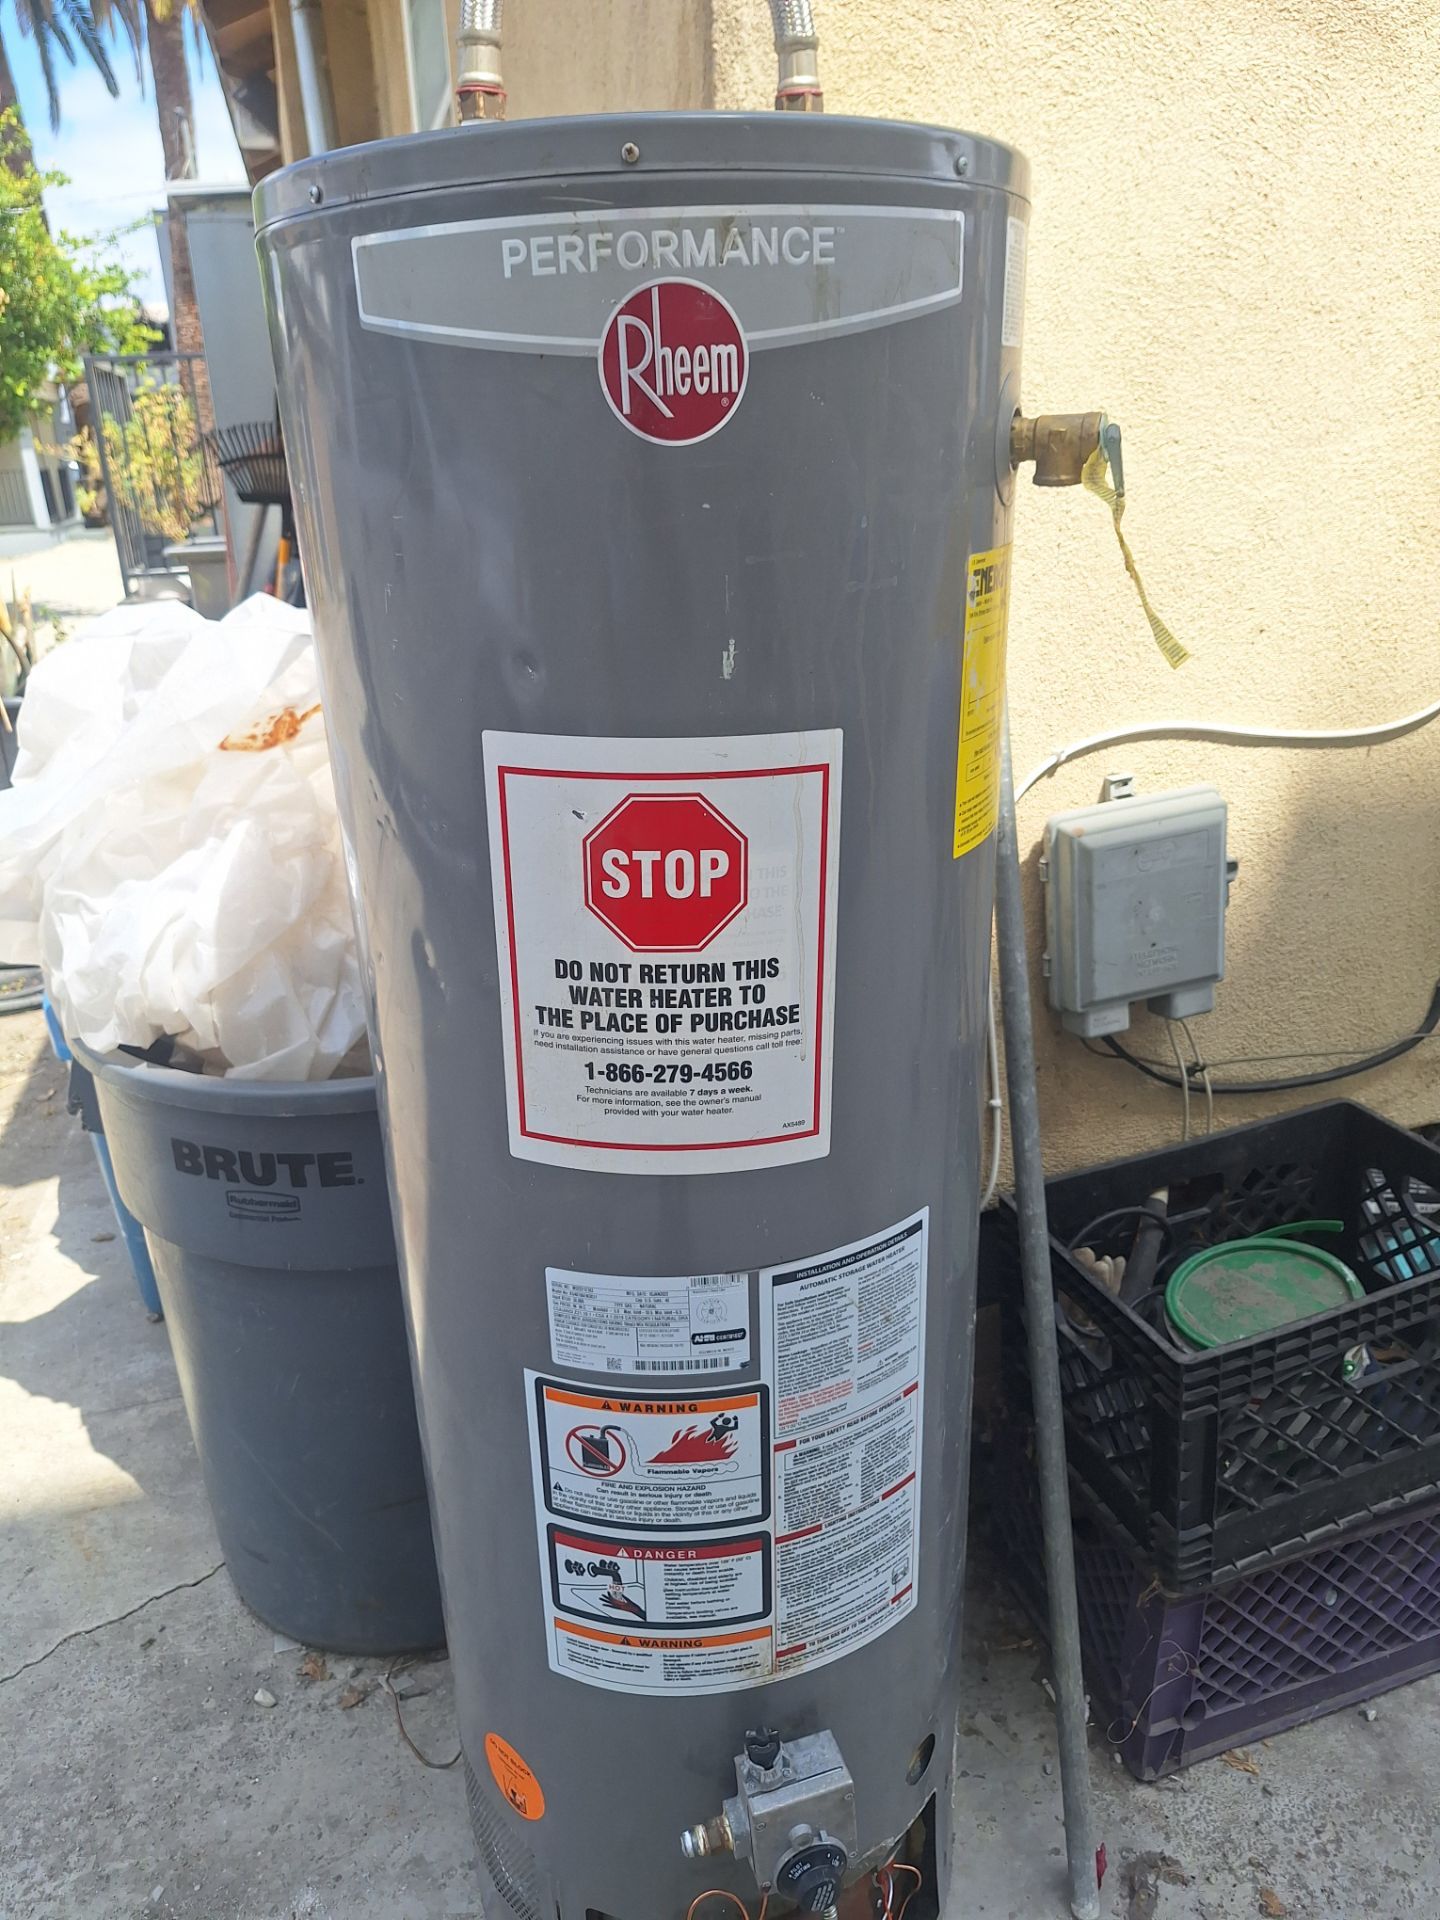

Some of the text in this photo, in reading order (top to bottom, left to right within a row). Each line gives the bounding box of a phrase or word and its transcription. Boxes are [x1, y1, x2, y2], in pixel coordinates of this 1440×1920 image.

[503, 226, 836, 278] PERFORMANCE
[616, 285, 738, 418] Rheem
[602, 849, 730, 899] STOP
[555, 958, 779, 984] DO NOT RETURN THIS
[569, 984, 765, 1008] WATER HEATER TO
[535, 1004, 800, 1033] THE PLACE OF PURCHASE
[540, 1032, 554, 1040] you
[572, 1035, 623, 1046] experiencing
[626, 1037, 652, 1045] issues
[655, 1037, 672, 1045] with
[674, 1037, 690, 1045] this
[692, 1037, 715, 1045] water
[717, 1035, 746, 1044] heater,
[748, 1031, 778, 1042] missing
[780, 1029, 803, 1039] parts,
[534, 1039, 553, 1048] need
[555, 1041, 598, 1053] installation
[601, 1045, 644, 1056] assistance
[658, 1047, 678, 1056] have
[680, 1047, 712, 1057] general
[714, 1043, 754, 1056] questions
[756, 1042, 769, 1051] call
[771, 1040, 783, 1049] toll
[584, 1061, 752, 1083] 1-866-279-4566
[576, 1094, 590, 1102] For
[615, 1098, 663, 1107] information,
[683, 1099, 697, 1107] the
[699, 1097, 729, 1106] owner's
[732, 1094, 762, 1103] manual
[585, 1086, 633, 1097] Technicians
[650, 1089, 687, 1097] available
[697, 1087, 718, 1097] days
[728, 1085, 753, 1094] week.
[604, 1106, 734, 1117] provided with your water heater.
[171, 1137, 356, 1188] BRUTE
[796, 1261, 841, 1279] INSTALLATION
[841, 1257, 855, 1266] AND
[856, 1244, 887, 1260] OPERATION
[800, 1246, 905, 1291] AUTOMATIC STORAGE WATER HEATER
[620, 1402, 698, 1413] WARNING
[692, 1467, 718, 1475] Vapors
[633, 1550, 697, 1559] DANGER
[638, 1639, 703, 1648] WARNING
[790, 1862, 803, 1874] PILOT
